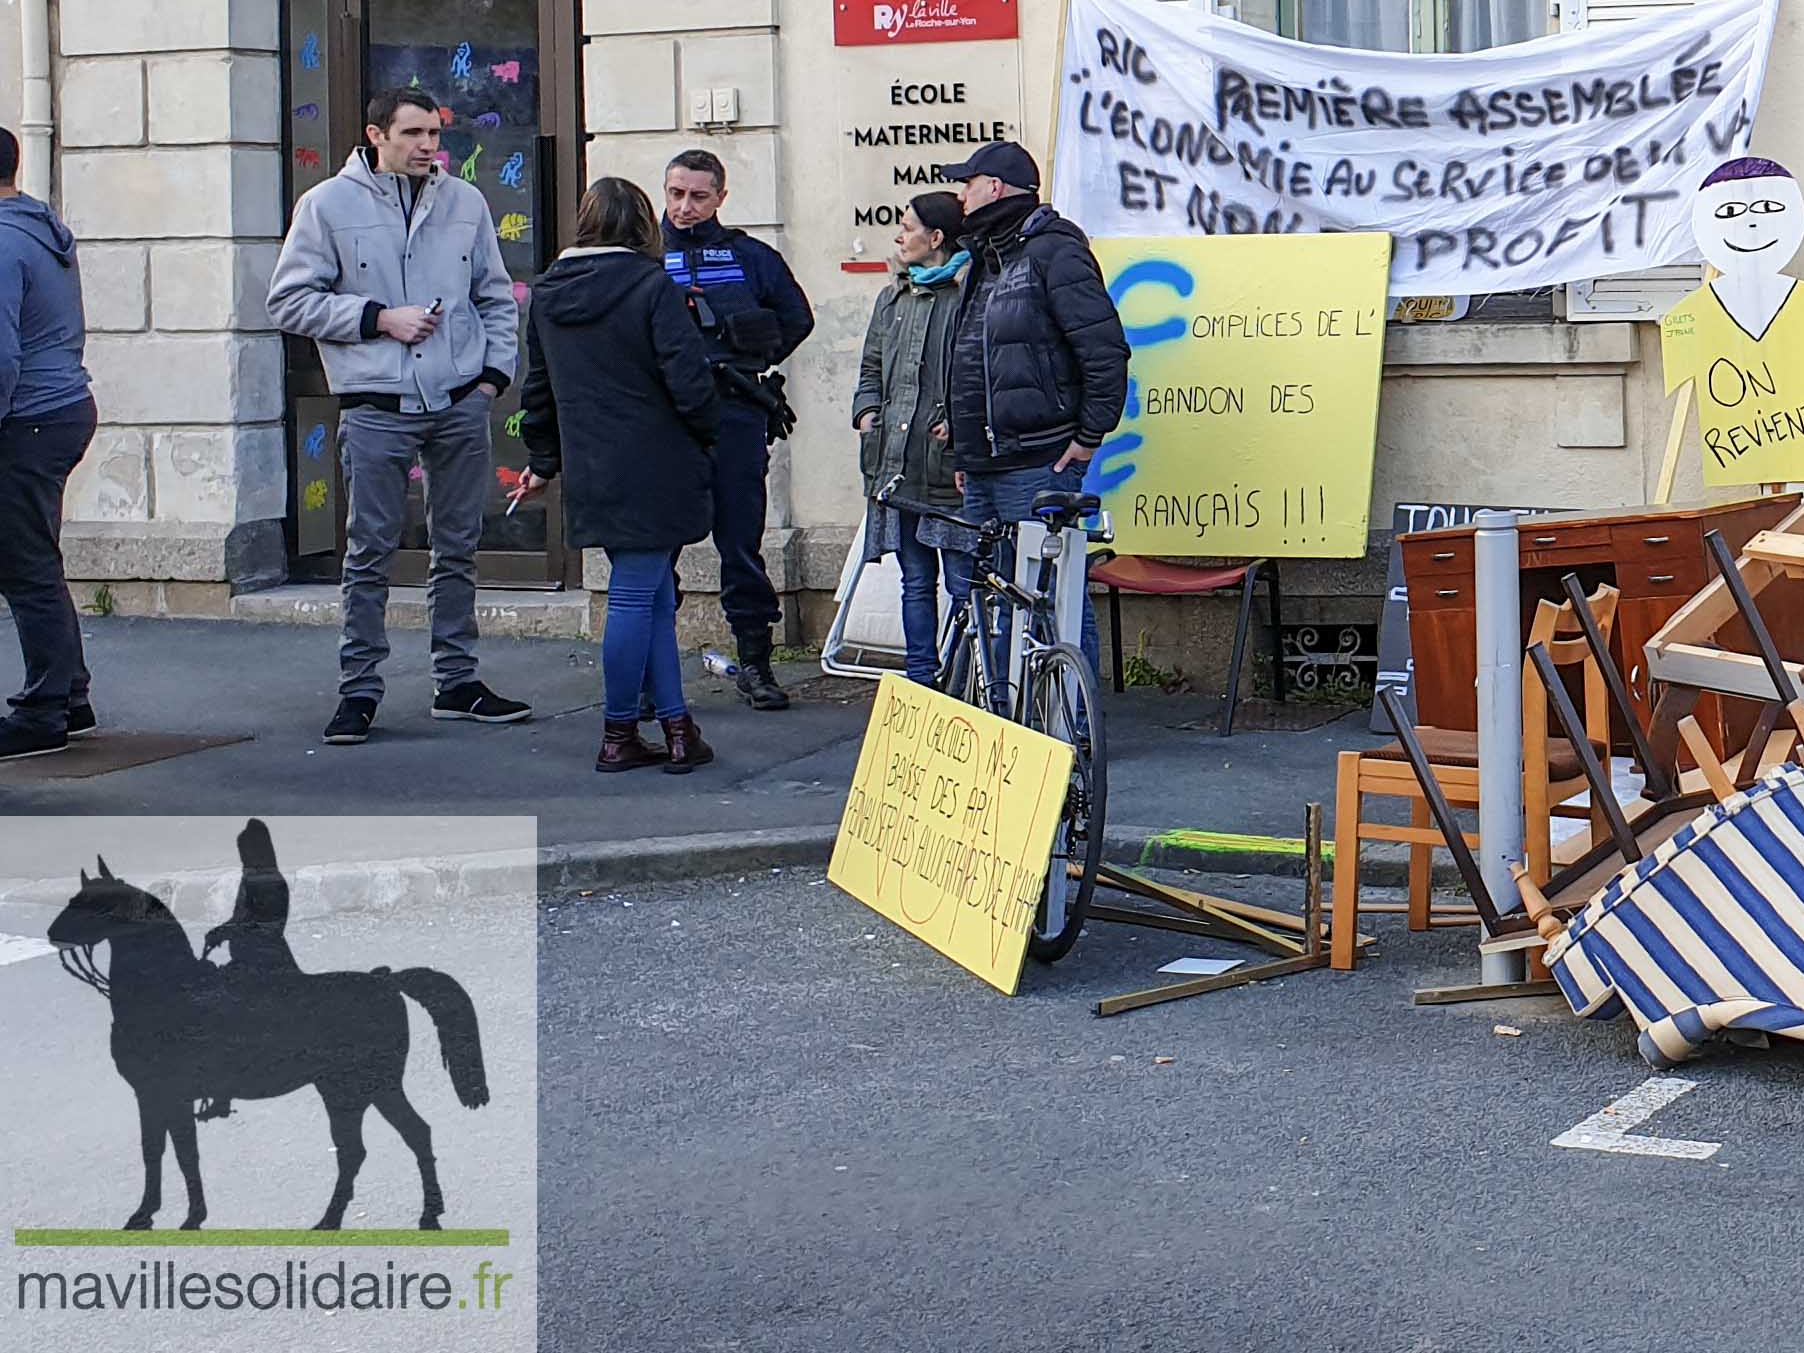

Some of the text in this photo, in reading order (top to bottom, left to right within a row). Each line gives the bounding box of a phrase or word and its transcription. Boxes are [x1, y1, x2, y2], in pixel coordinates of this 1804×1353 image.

[1098, 28, 1157, 84] RIC
[890, 79, 966, 105] ÉCOLE
[1448, 31, 1723, 135] ASSEMBLÉE
[854, 122, 1005, 147] MATERNELLE
[1118, 160, 1178, 211] ET
[1416, 188, 1679, 270] PROFIT
[1318, 311, 1343, 337] DE
[1270, 385, 1314, 414] DES
[1708, 357, 1776, 408] ON
[931, 775, 960, 819] DES
[963, 786, 993, 835] APL
